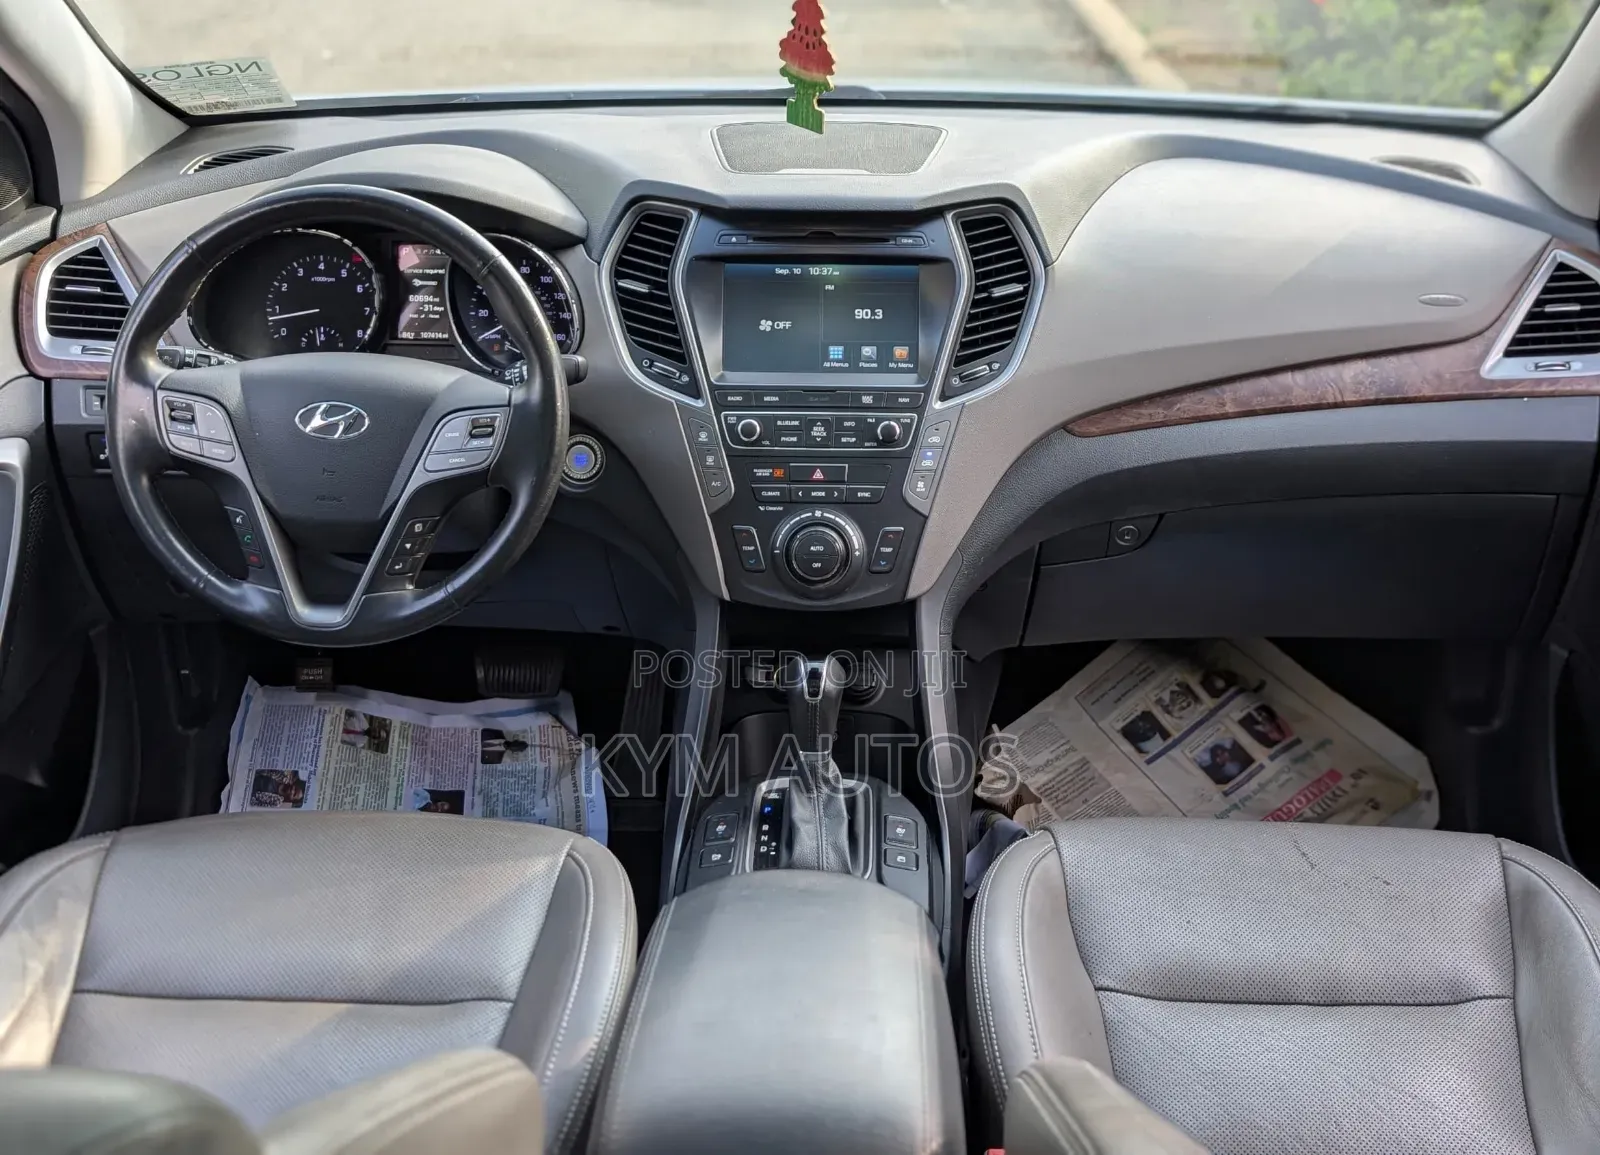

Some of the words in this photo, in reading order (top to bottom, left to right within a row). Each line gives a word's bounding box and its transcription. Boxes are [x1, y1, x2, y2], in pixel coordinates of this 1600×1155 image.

[318, 262, 325, 270] 4
[520, 266, 530, 274] 80
[297, 268, 304, 277] 3
[341, 269, 348, 278] 5
[775, 267, 791, 275] Sep.
[793, 267, 801, 275] 10
[808, 267, 833, 276] 10:37
[357, 285, 363, 293] 6
[554, 292, 567, 300] 120
[478, 309, 489, 317] 20
[559, 312, 572, 320] 140
[854, 308, 883, 320] 90.3
[774, 321, 792, 330] OFF
[280, 328, 287, 336] 0
[357, 330, 364, 338] 8
